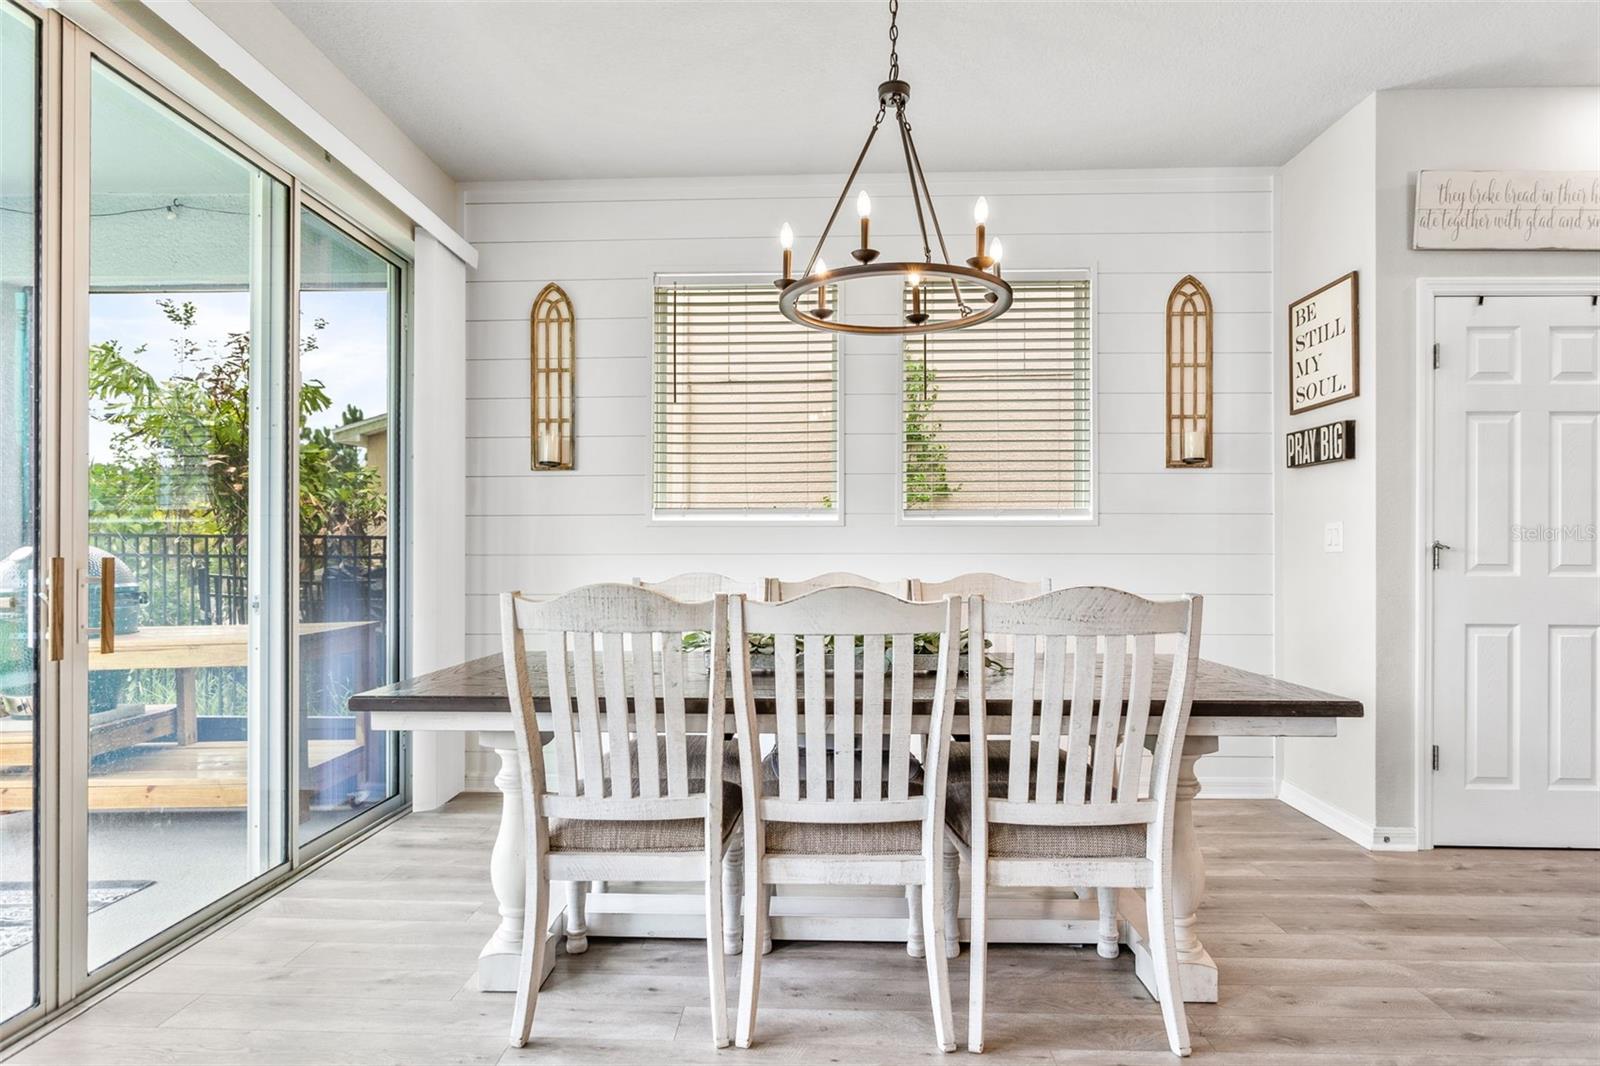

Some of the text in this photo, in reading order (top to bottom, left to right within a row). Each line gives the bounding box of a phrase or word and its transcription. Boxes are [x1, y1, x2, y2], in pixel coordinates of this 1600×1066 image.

[1437, 178, 1600, 216] they broke bread in their h
[1420, 209, 1437, 230] ate
[1441, 204, 1490, 241] together
[1494, 205, 1521, 230] with
[1524, 205, 1555, 241] glad
[1559, 206, 1583, 230] and
[1296, 302, 1317, 327] BE
[1296, 318, 1346, 352] STILL
[1296, 353, 1323, 378] MY
[1296, 374, 1347, 403] SOUL.
[1287, 423, 1343, 467] PRAY BIG
